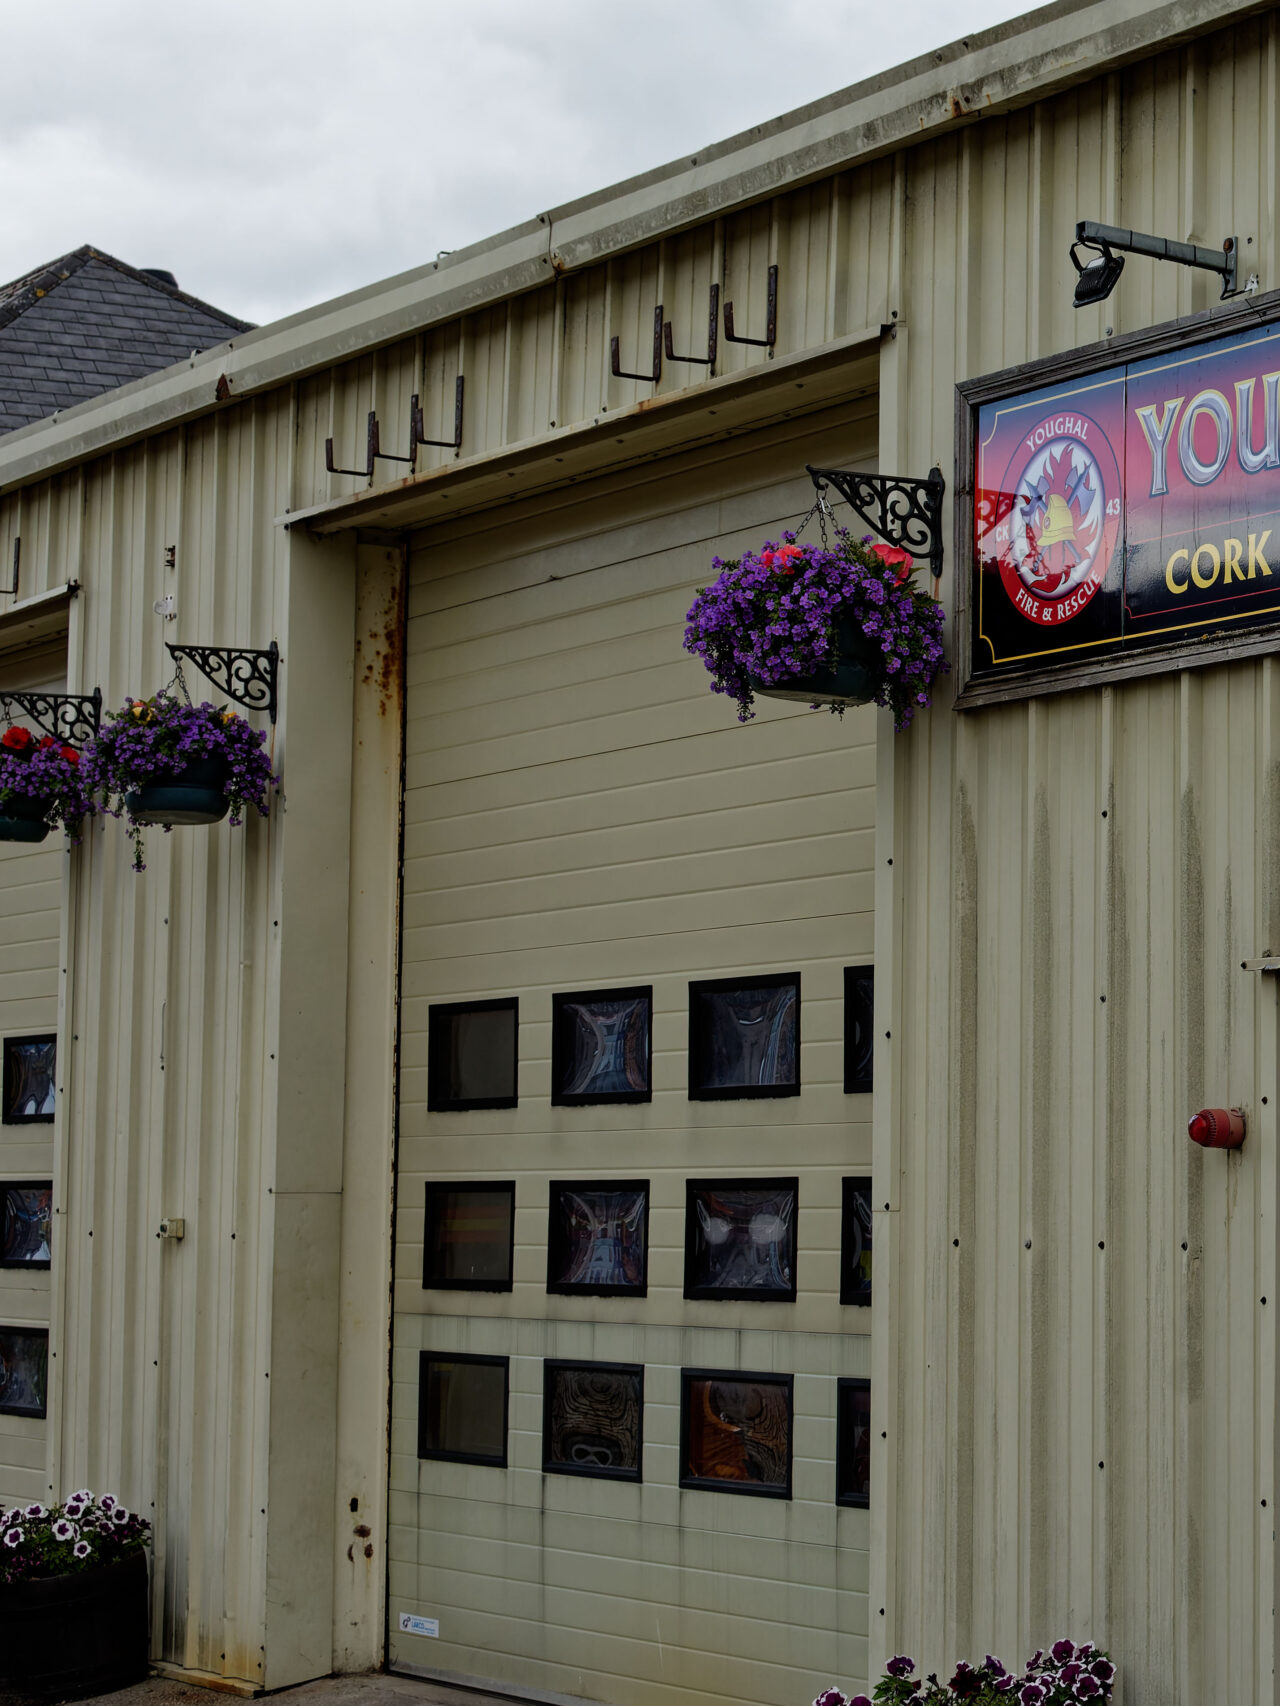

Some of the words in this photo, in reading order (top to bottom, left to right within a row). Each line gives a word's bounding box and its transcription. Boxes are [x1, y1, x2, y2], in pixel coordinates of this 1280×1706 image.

[1026, 416, 1089, 453] YOUGHAL
[1106, 498, 1121, 516] 43
[995, 524, 1010, 543] CK
[1165, 530, 1273, 595] CORK
[1016, 587, 1040, 619] FIRE
[1042, 606, 1053, 622] &
[1056, 569, 1101, 621] RESCUE
